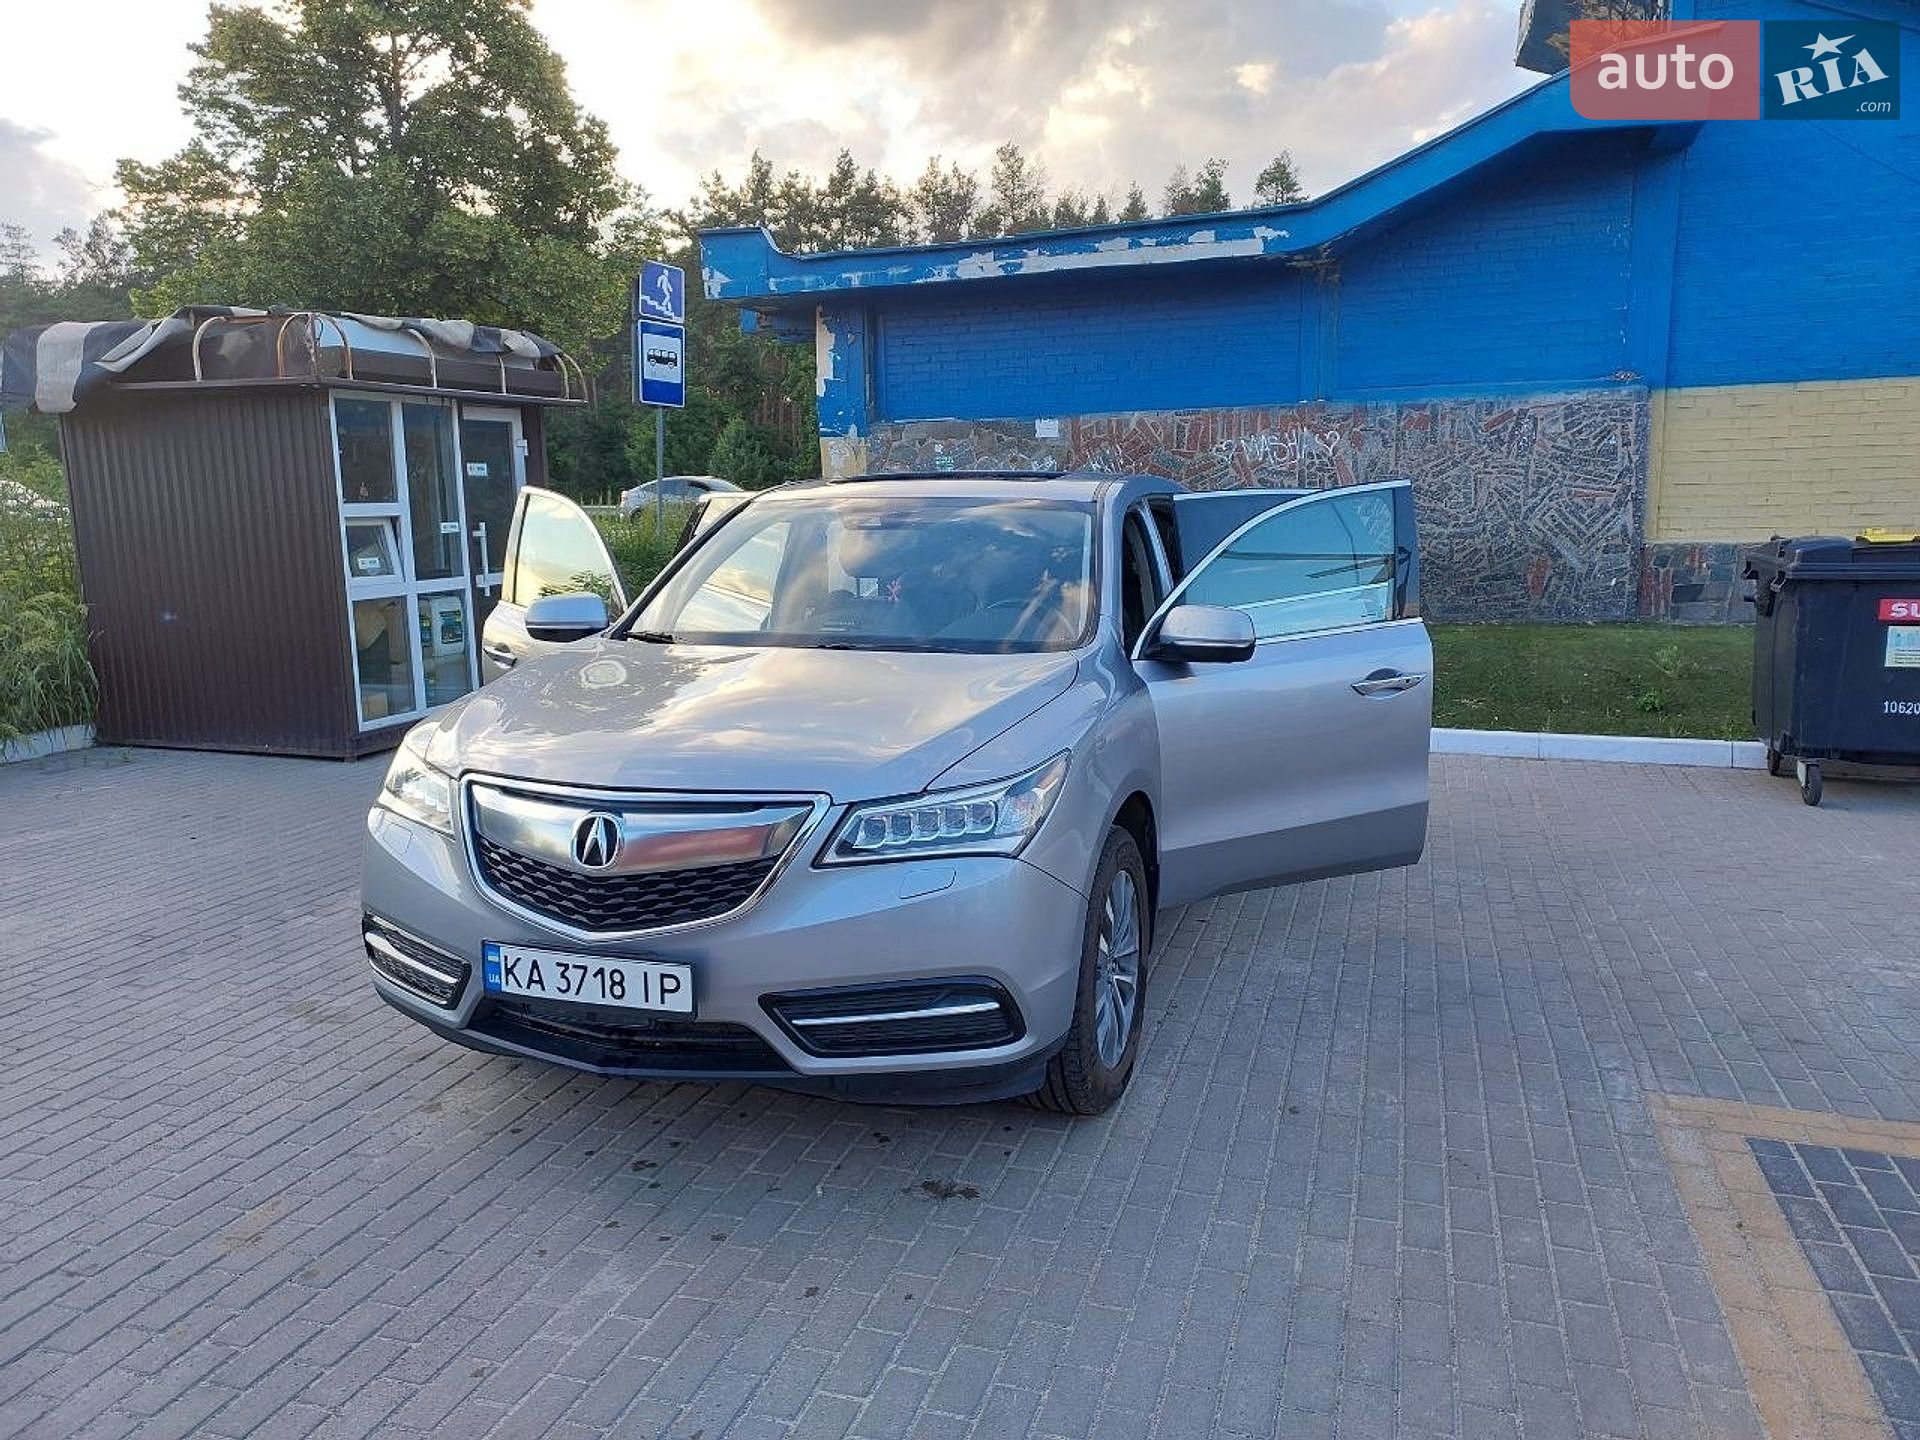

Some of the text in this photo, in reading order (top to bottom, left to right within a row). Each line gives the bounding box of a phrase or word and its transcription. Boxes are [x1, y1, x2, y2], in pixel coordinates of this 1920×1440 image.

[489, 973, 500, 984] UA
[503, 955, 681, 1005] KA 3718 IP
